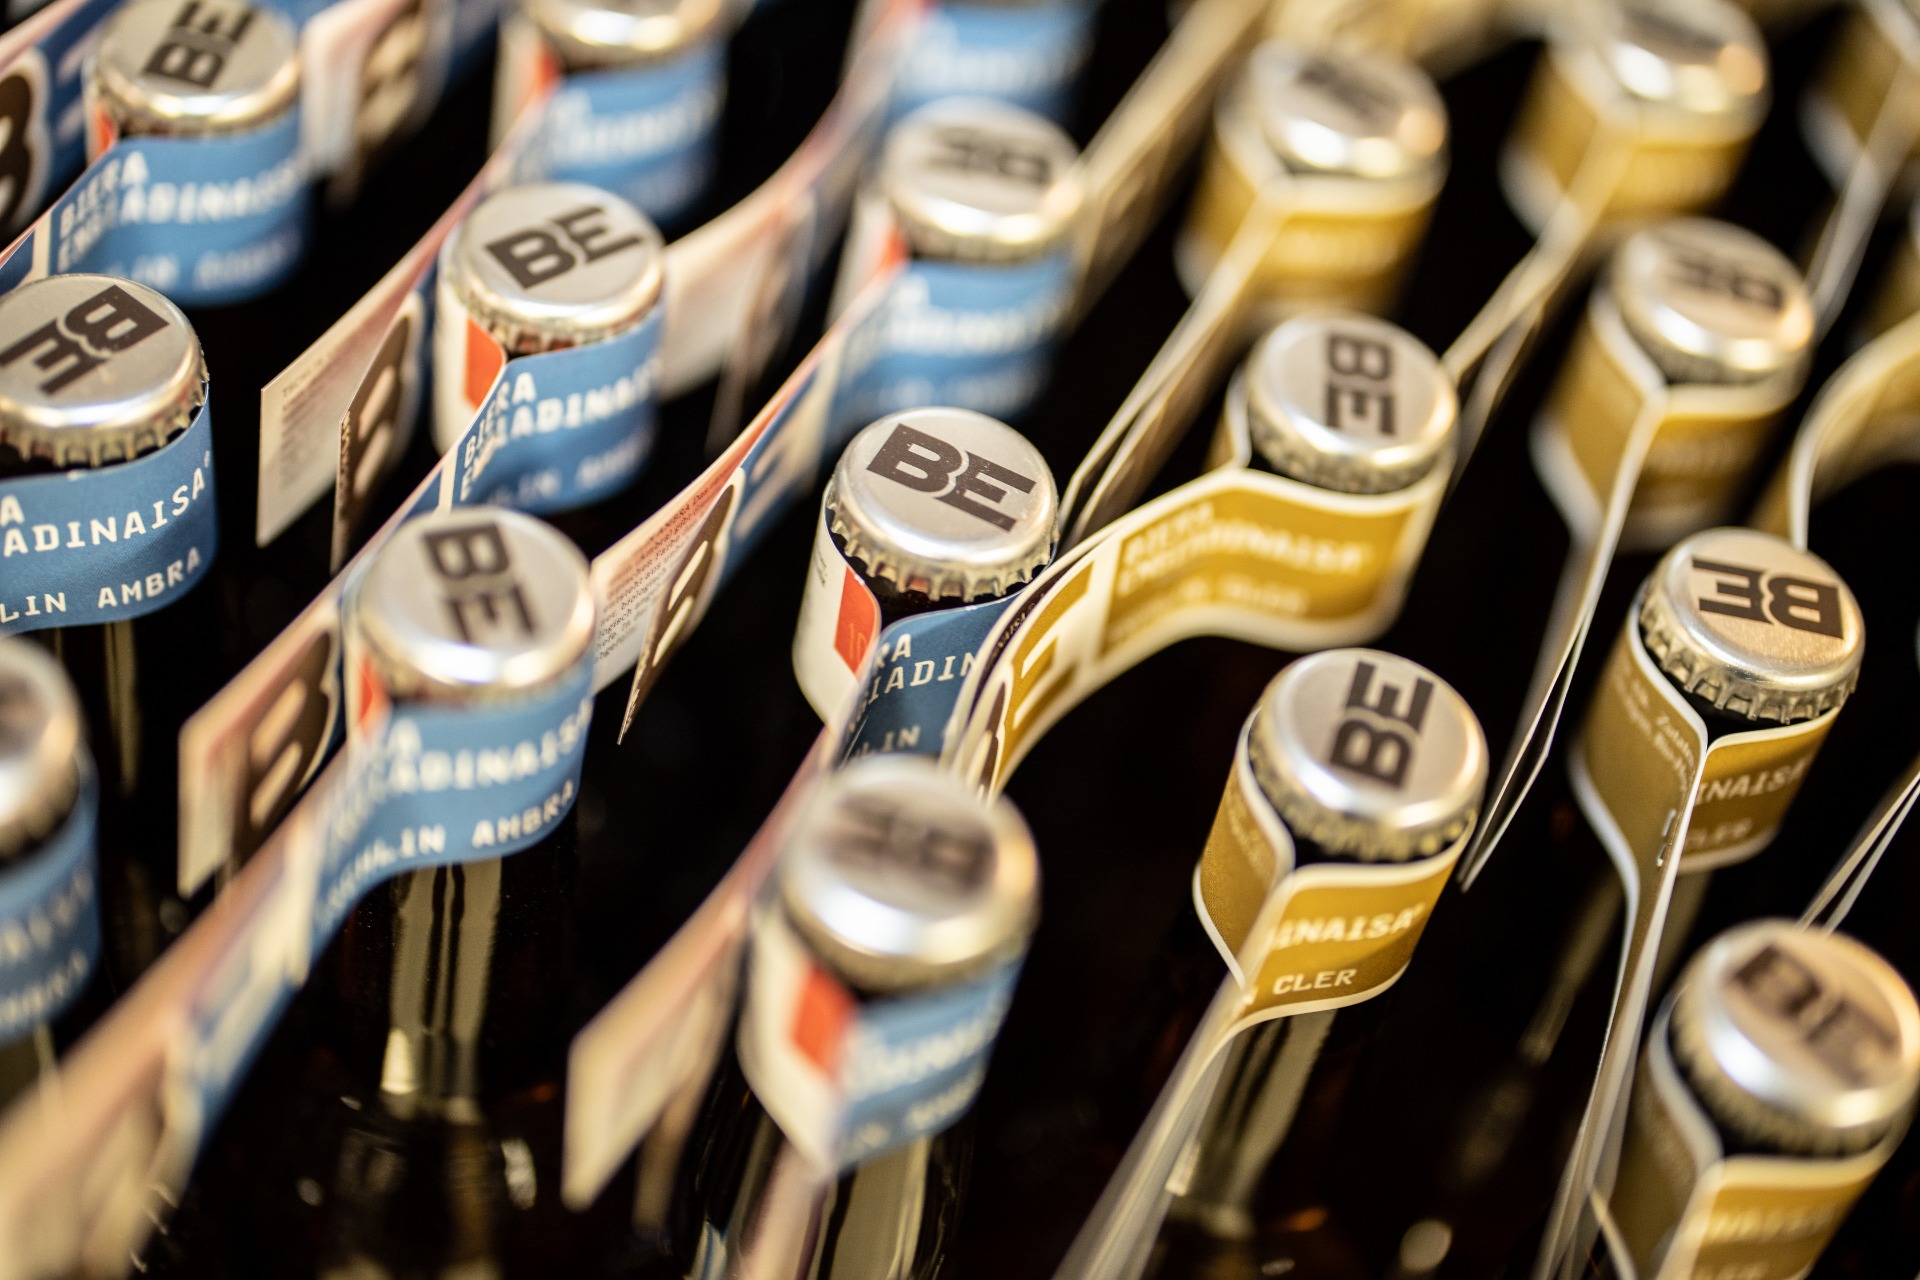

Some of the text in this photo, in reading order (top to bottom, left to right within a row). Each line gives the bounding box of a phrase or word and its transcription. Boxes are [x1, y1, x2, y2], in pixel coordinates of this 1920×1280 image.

[143, 2, 257, 89] BE
[484, 204, 643, 290] BE
[0, 284, 170, 395] BE
[1325, 331, 1397, 436] BE
[865, 422, 1037, 532] BE
[97, 546, 201, 609] AMBRA
[421, 522, 537, 646] BE
[1690, 556, 1845, 639] BE
[1330, 660, 1435, 791] BE
[472, 779, 574, 848] AMBRA
[1271, 968, 1357, 995] CLER
